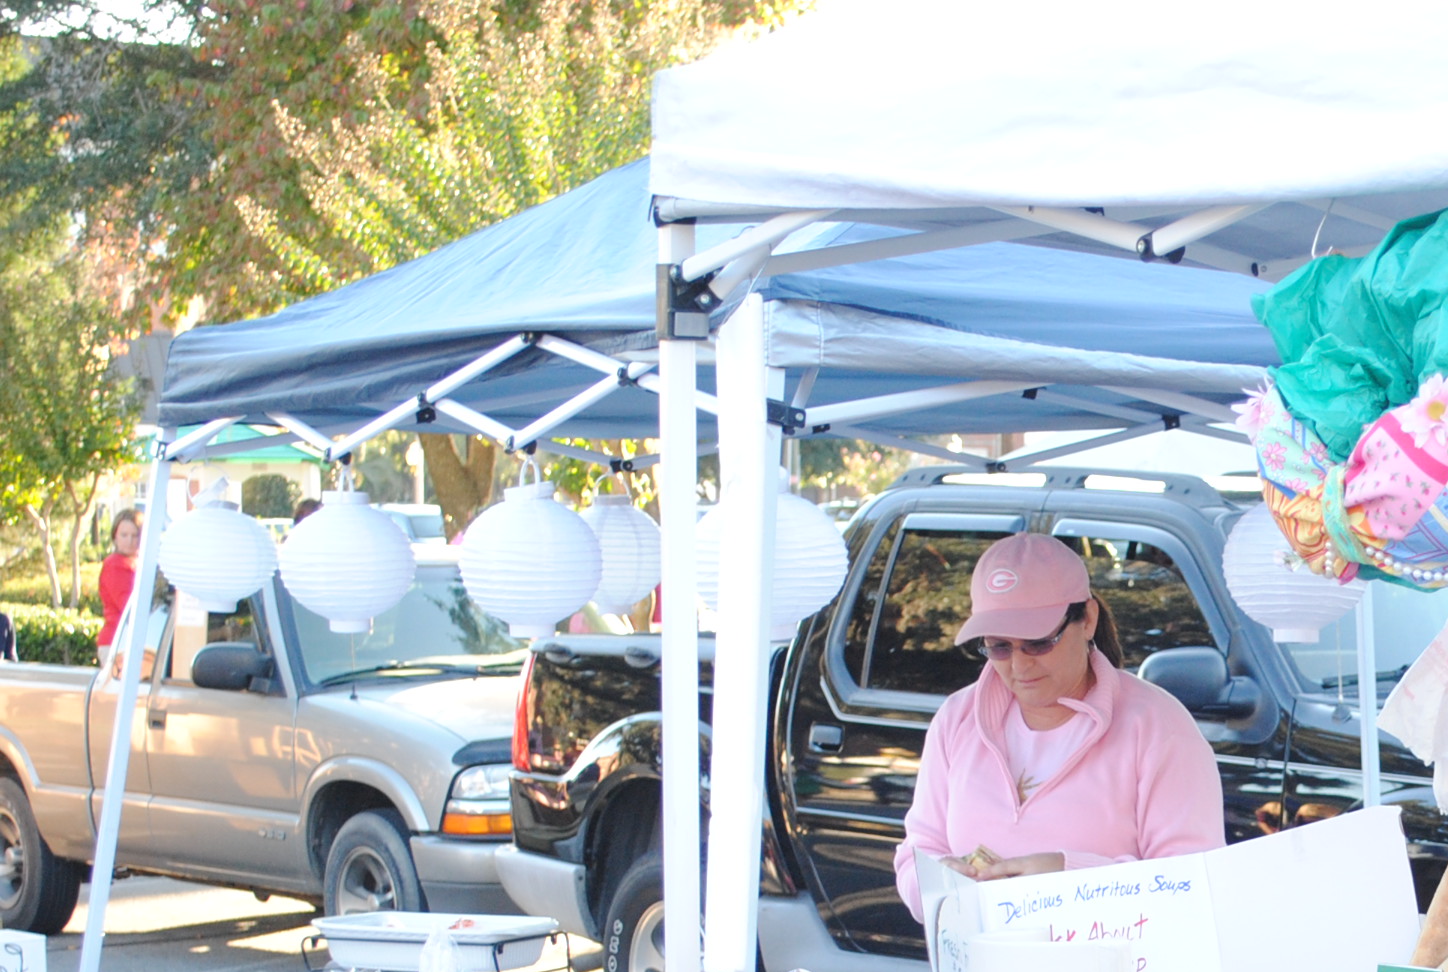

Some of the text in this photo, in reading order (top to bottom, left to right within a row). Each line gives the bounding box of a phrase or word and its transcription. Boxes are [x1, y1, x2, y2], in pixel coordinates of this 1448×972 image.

[997, 875, 1191, 924] Delicious Nutritous Soups
